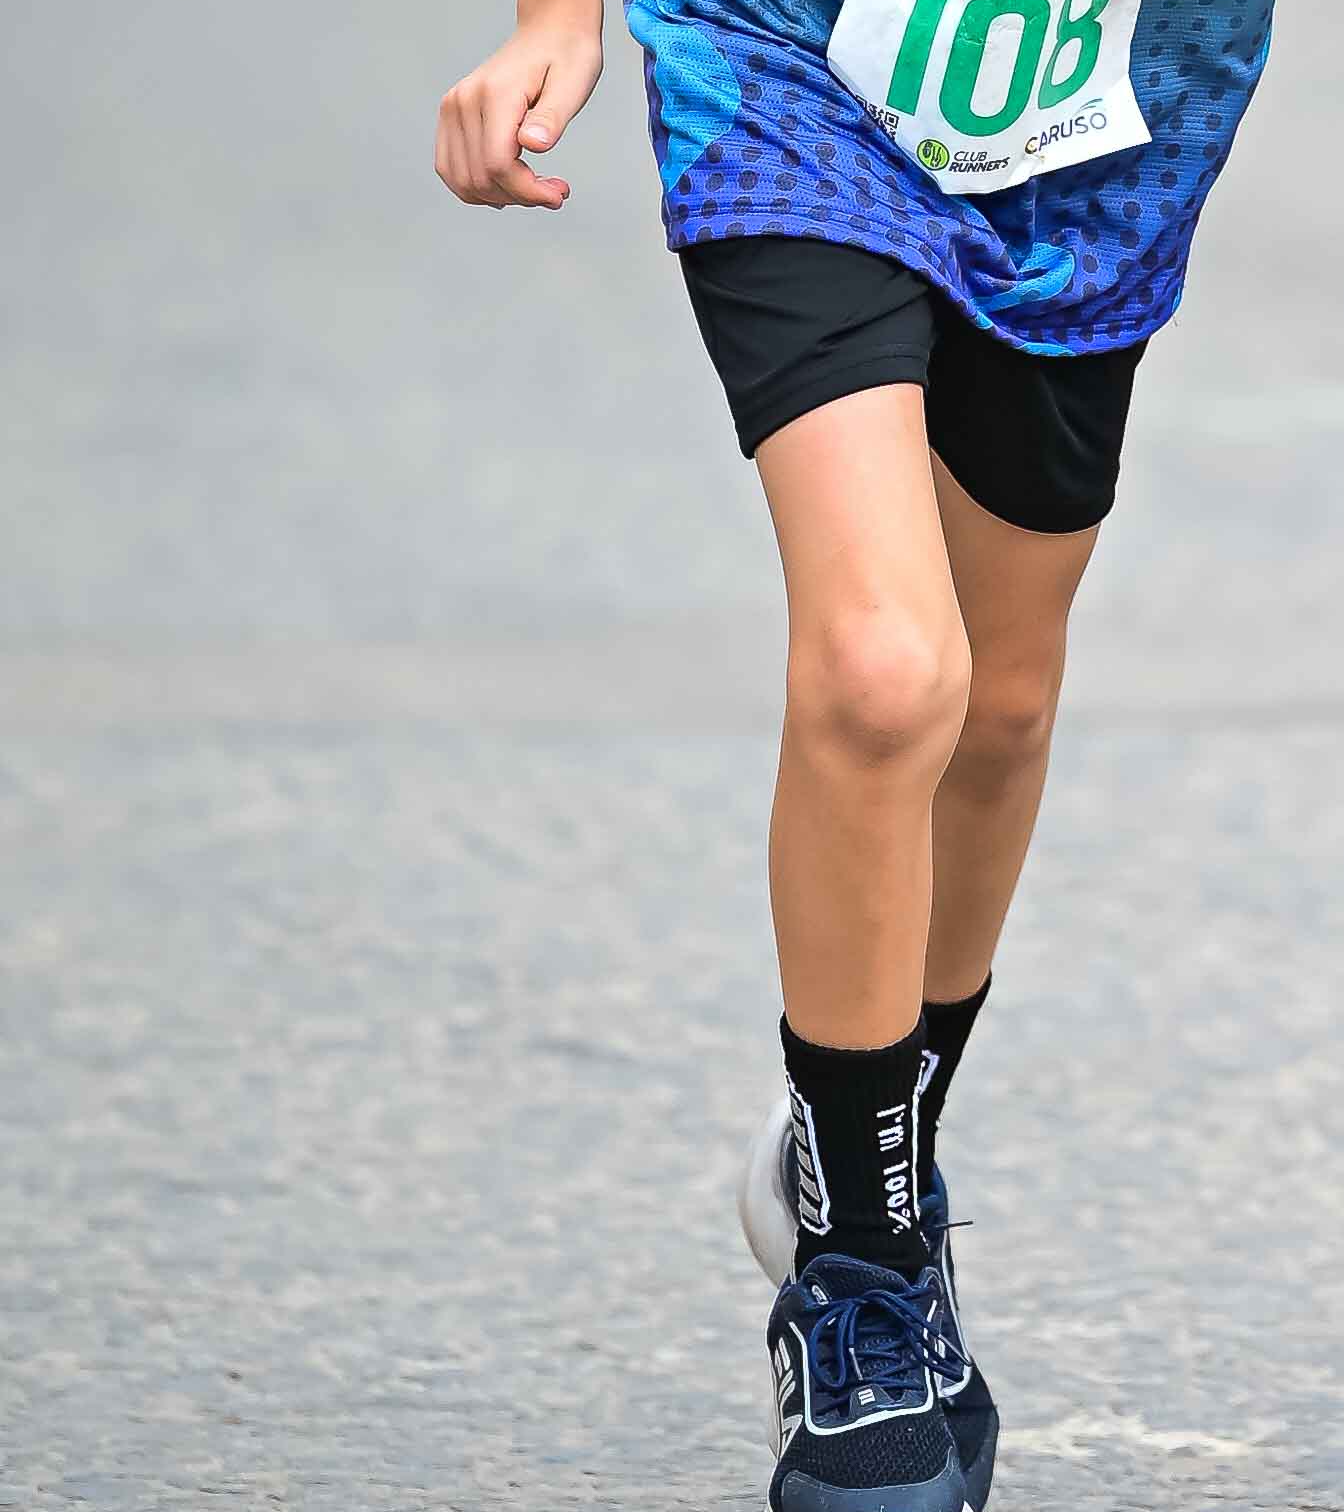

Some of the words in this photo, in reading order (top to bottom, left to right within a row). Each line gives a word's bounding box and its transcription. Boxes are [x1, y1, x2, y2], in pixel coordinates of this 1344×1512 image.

[1025, 112, 1107, 154] CARUSO
[953, 150, 988, 162] CLUB
[876, 1103, 907, 1152] I'm
[883, 1160, 912, 1235] 100%
